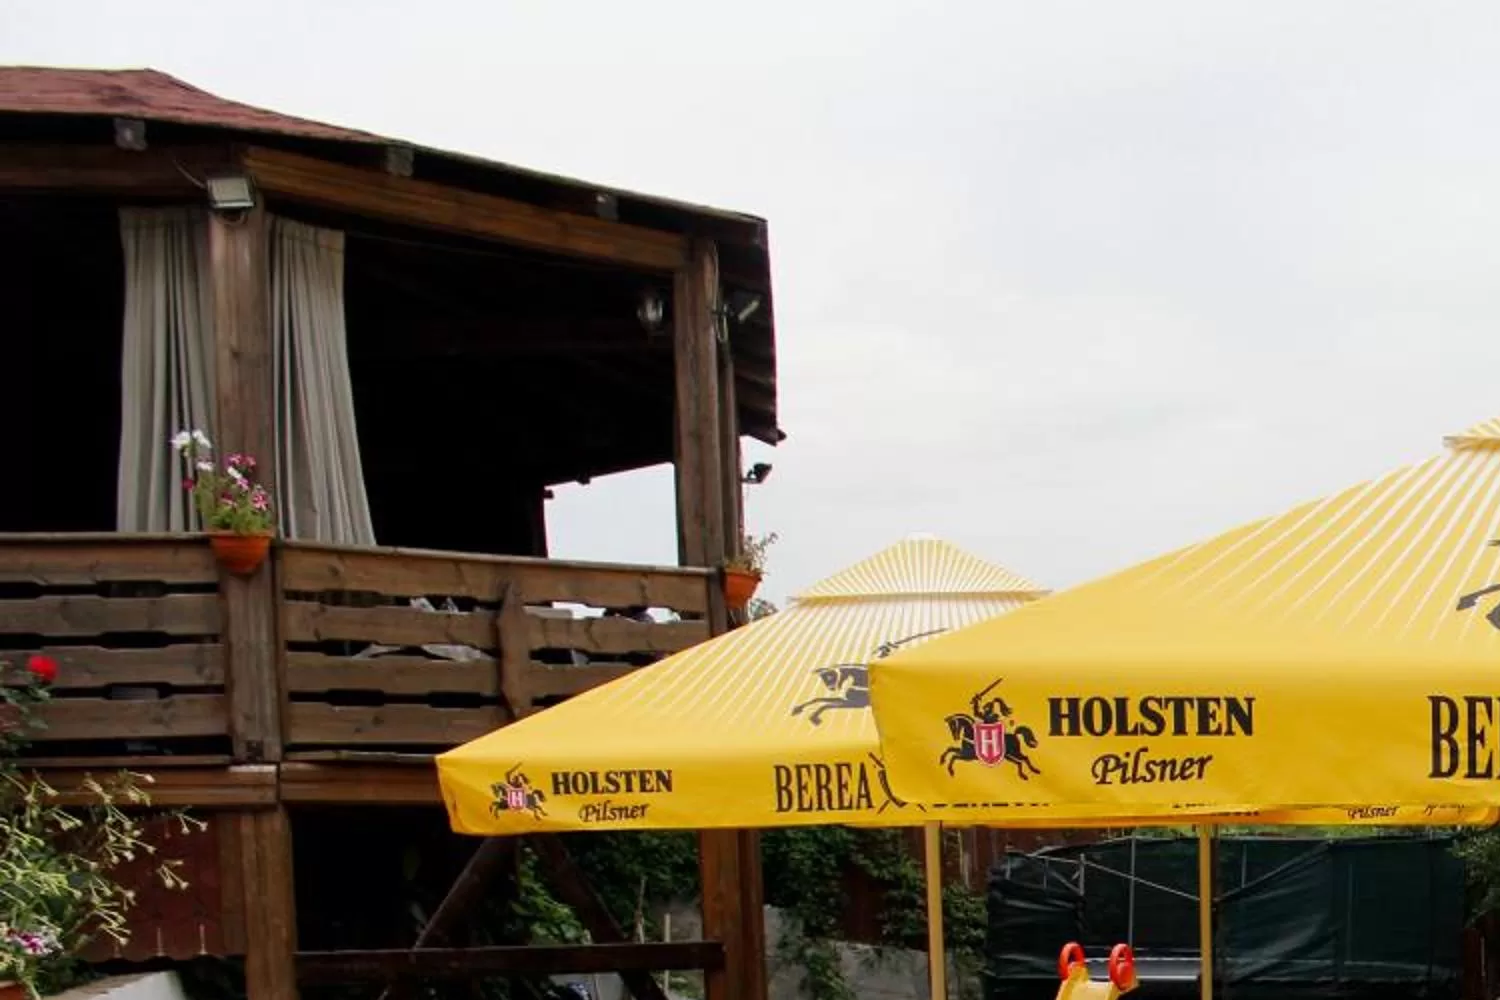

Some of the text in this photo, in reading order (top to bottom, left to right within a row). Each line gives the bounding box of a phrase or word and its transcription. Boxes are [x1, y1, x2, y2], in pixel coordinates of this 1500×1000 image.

[1048, 697, 1255, 737] HOLSTEN
[981, 728, 1000, 757] H
[551, 770, 673, 795] HOLSTEN
[1092, 747, 1212, 785] Pilsner
[773, 762, 875, 812] BEREA
[578, 800, 650, 823] Pilsner
